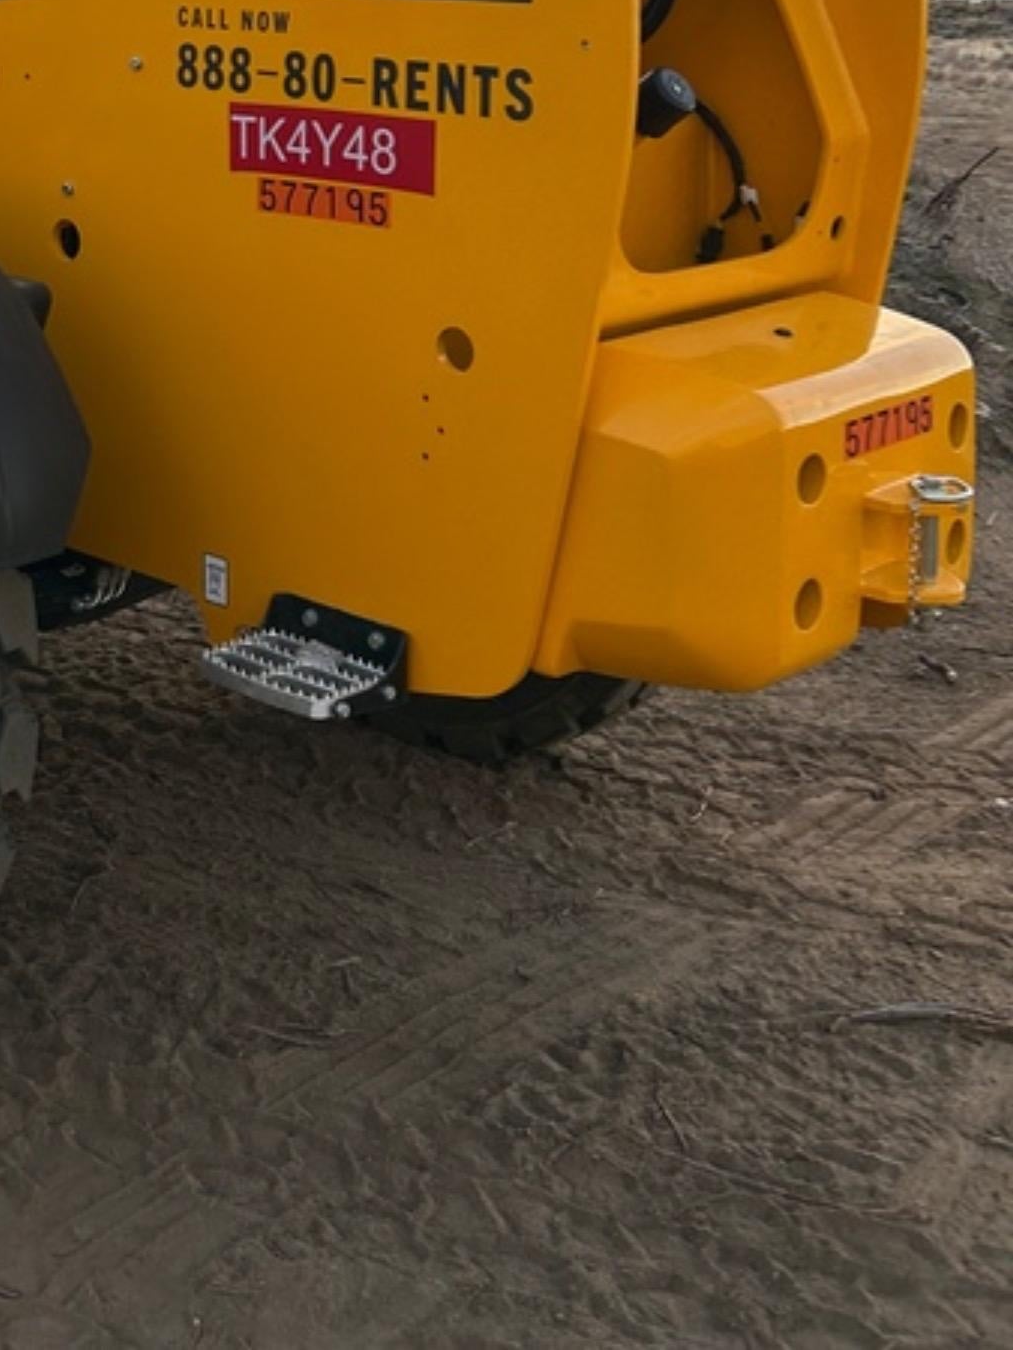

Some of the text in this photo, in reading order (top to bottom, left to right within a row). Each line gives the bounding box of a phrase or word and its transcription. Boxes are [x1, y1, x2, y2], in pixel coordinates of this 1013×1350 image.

[177, 6, 290, 33] CALL NOW
[177, 42, 534, 121] 888-80-RENTS
[231, 114, 397, 175] TK4Y48
[260, 179, 389, 226] 577195
[845, 395, 933, 458] 577195
